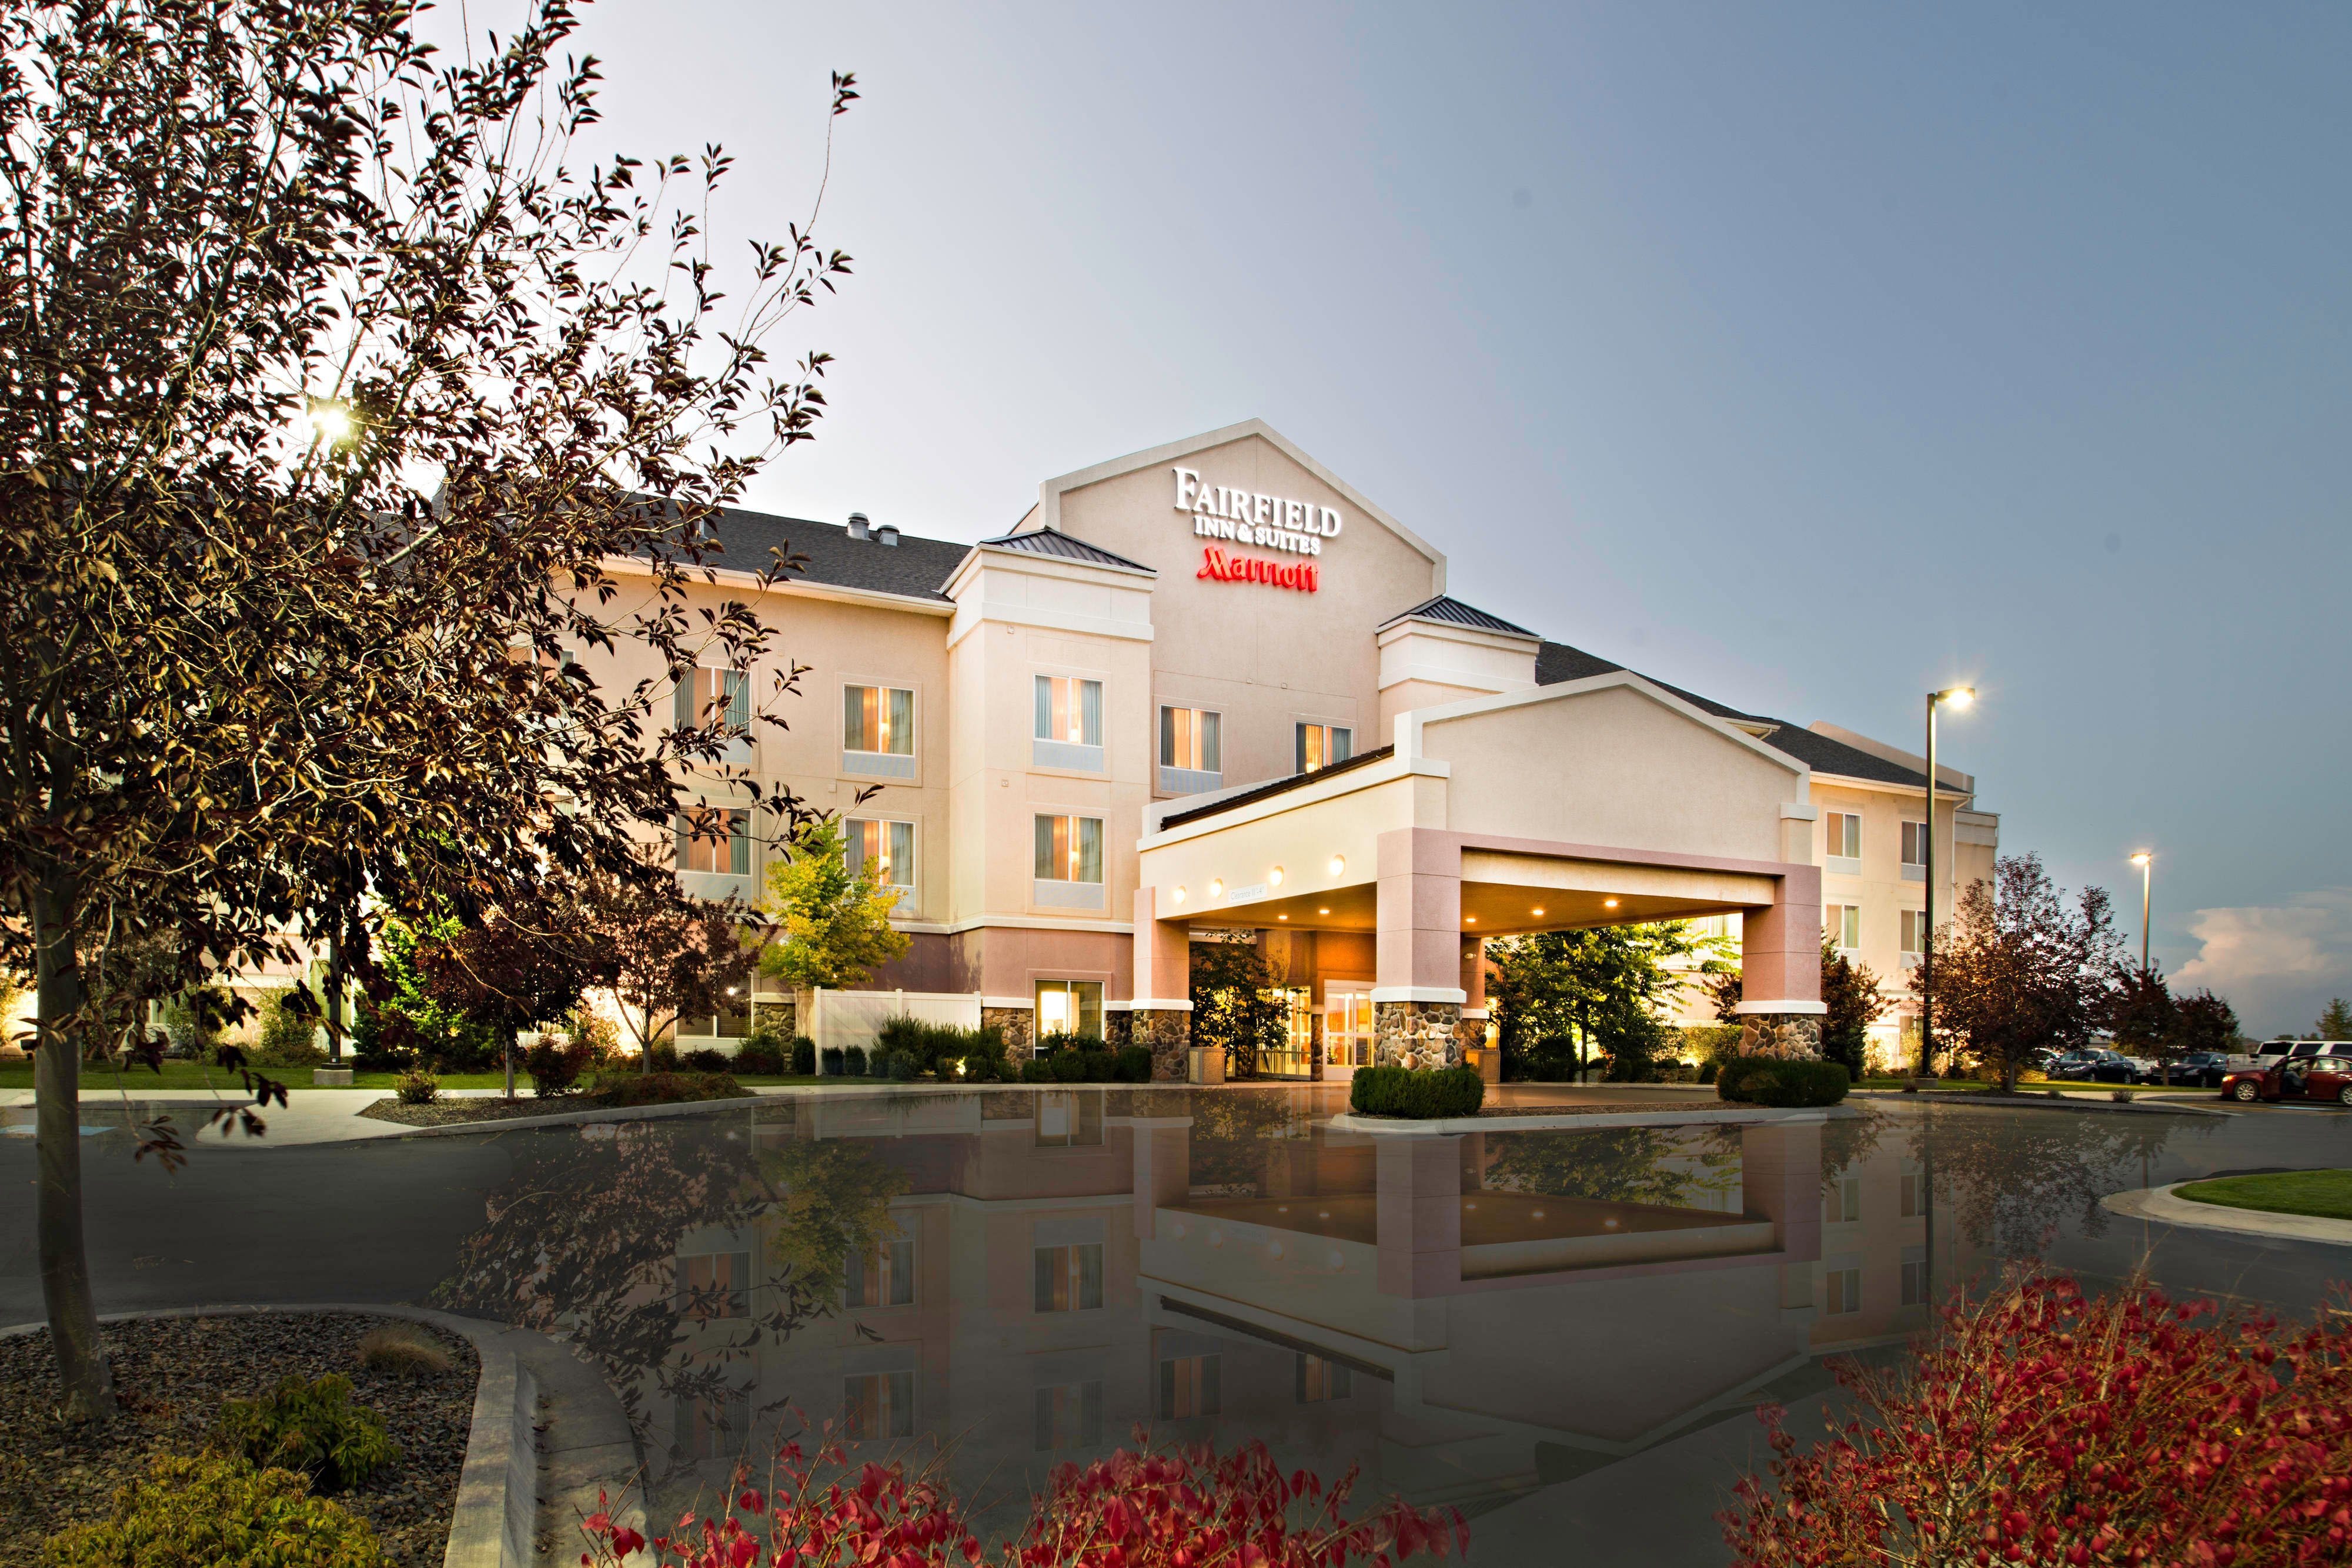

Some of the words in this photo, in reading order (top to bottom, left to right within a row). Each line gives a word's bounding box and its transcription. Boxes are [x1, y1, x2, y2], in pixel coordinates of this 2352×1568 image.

[1173, 467, 1341, 538] FAIRFIELD
[1194, 515, 1235, 539] INN
[1237, 523, 1254, 543] &
[1254, 526, 1320, 556] SUITES
[1197, 546, 1318, 592] Marriott
